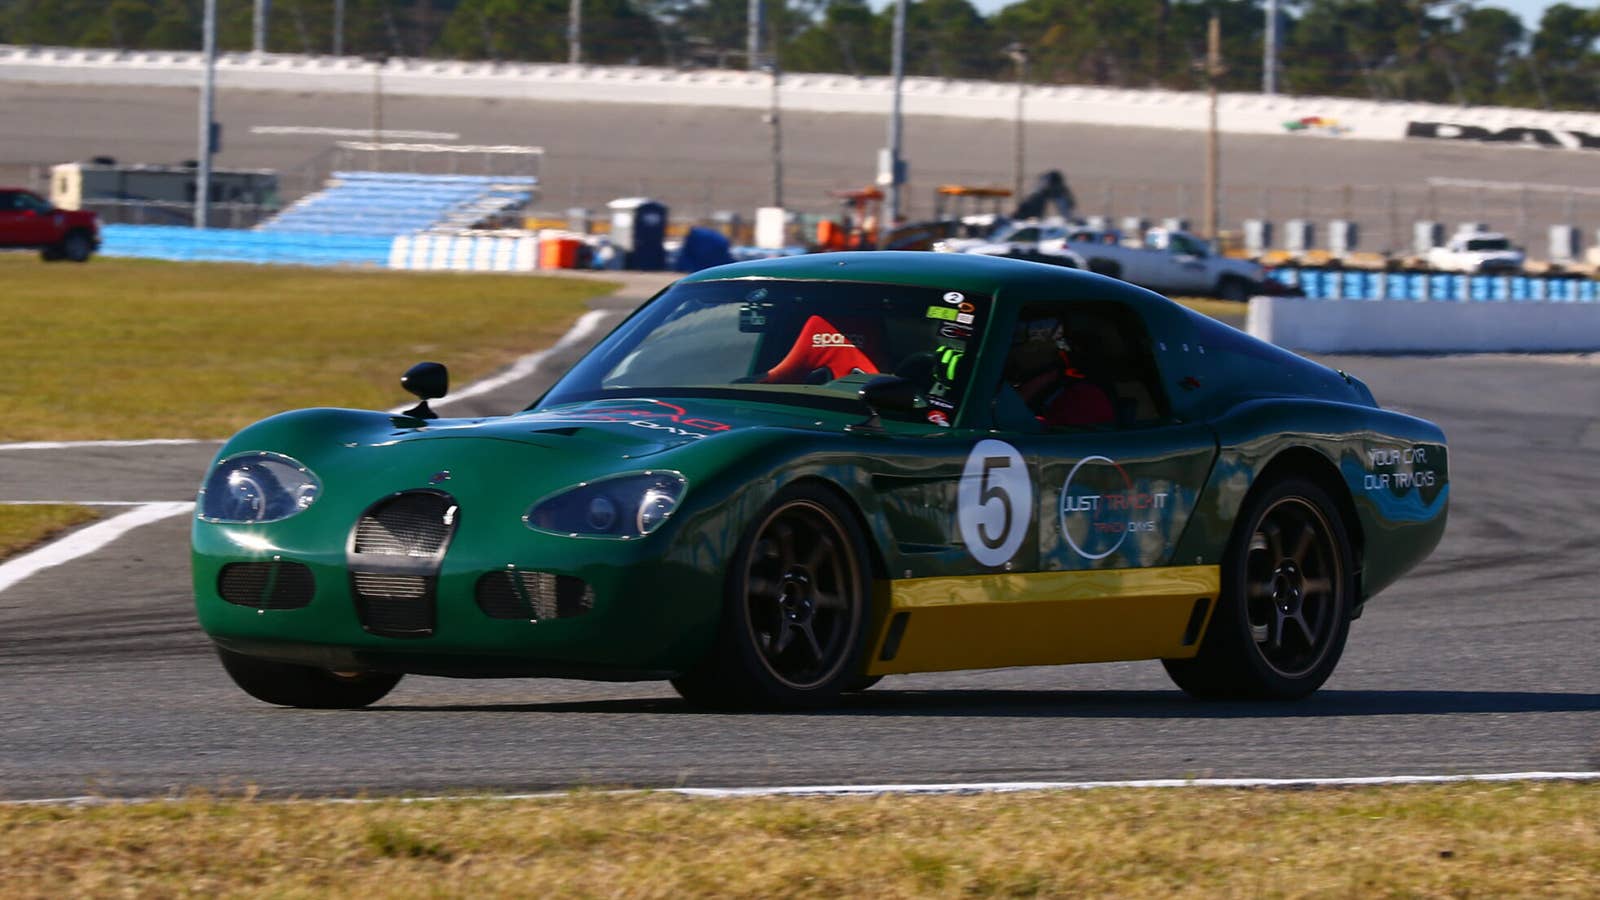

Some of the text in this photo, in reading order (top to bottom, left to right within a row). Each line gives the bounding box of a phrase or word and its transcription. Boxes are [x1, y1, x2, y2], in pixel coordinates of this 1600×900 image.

[1368, 448, 1401, 470] YOUR
[1363, 471, 1435, 490] OUR TRACKS
[977, 456, 1013, 550] 5
[1064, 495, 1101, 512] JUST
